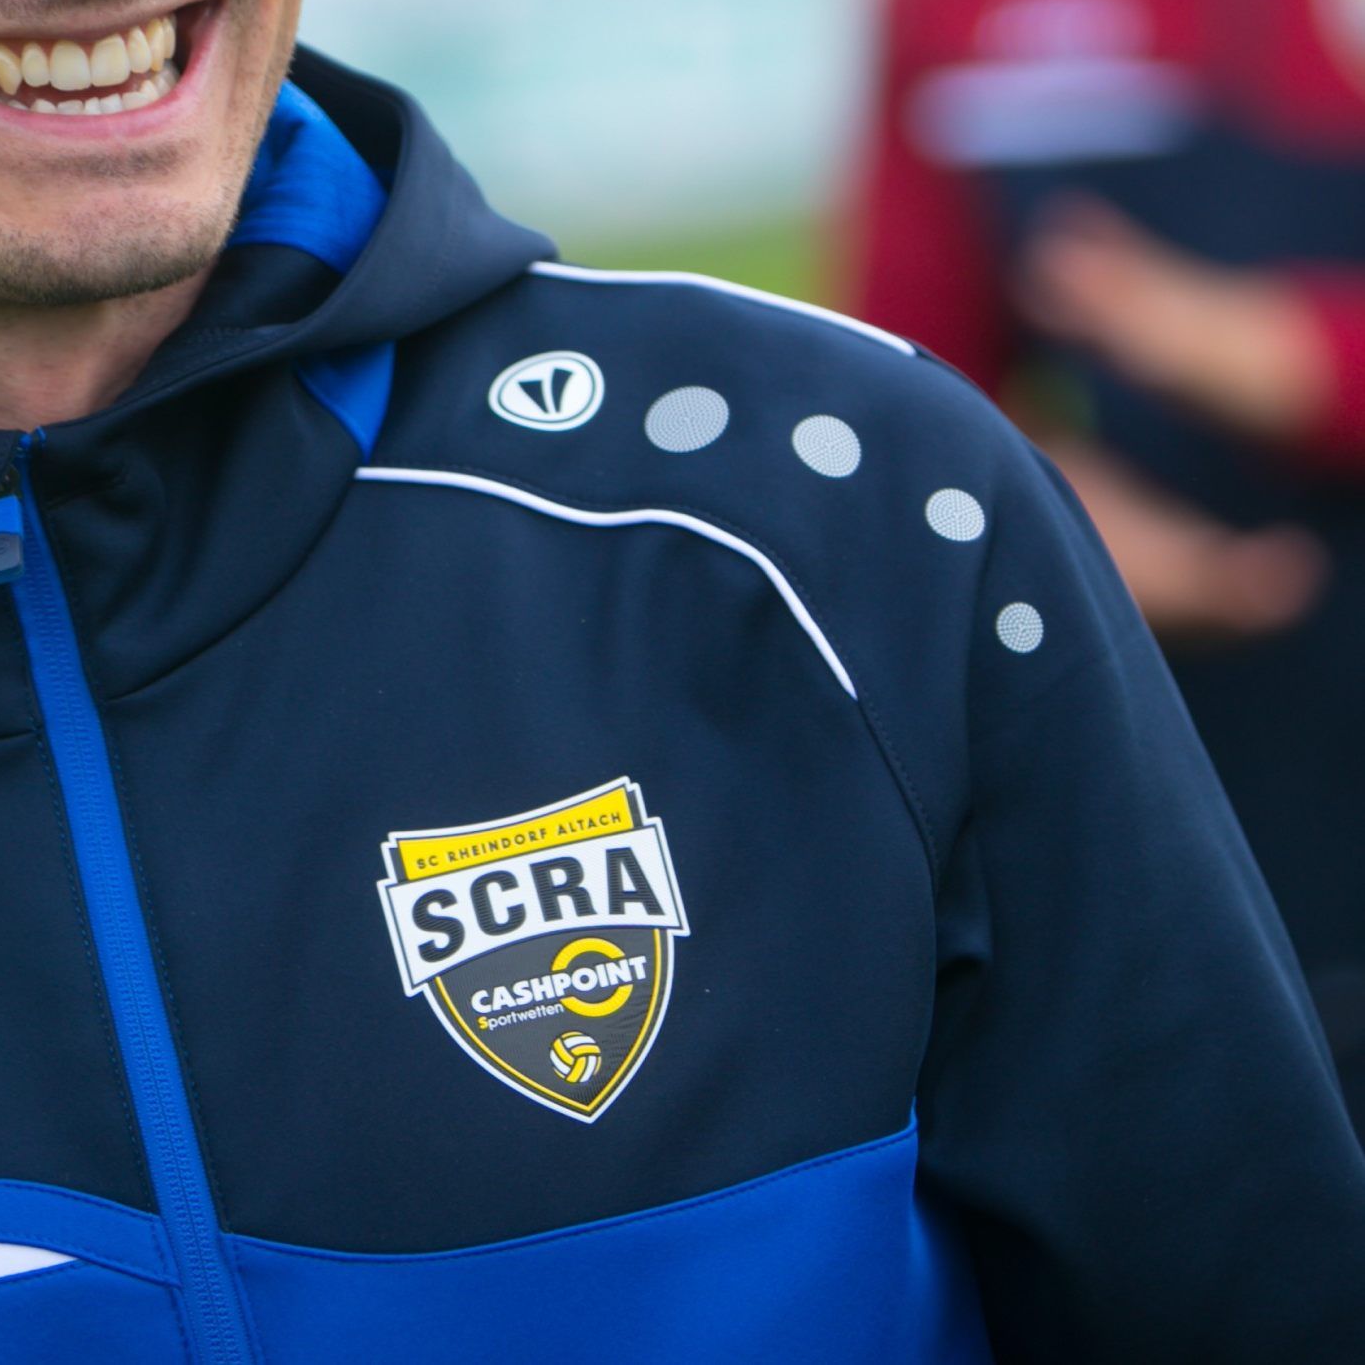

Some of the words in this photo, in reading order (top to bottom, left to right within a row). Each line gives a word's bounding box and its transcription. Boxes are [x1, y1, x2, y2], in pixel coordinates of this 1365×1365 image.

[416, 854, 439, 870] SC
[447, 828, 548, 863] RHEINDORF
[557, 811, 622, 836] ALTACH
[411, 847, 666, 964] SCRA
[471, 955, 647, 1014] CASHPOINT
[477, 1002, 565, 1030] Sportwetten
